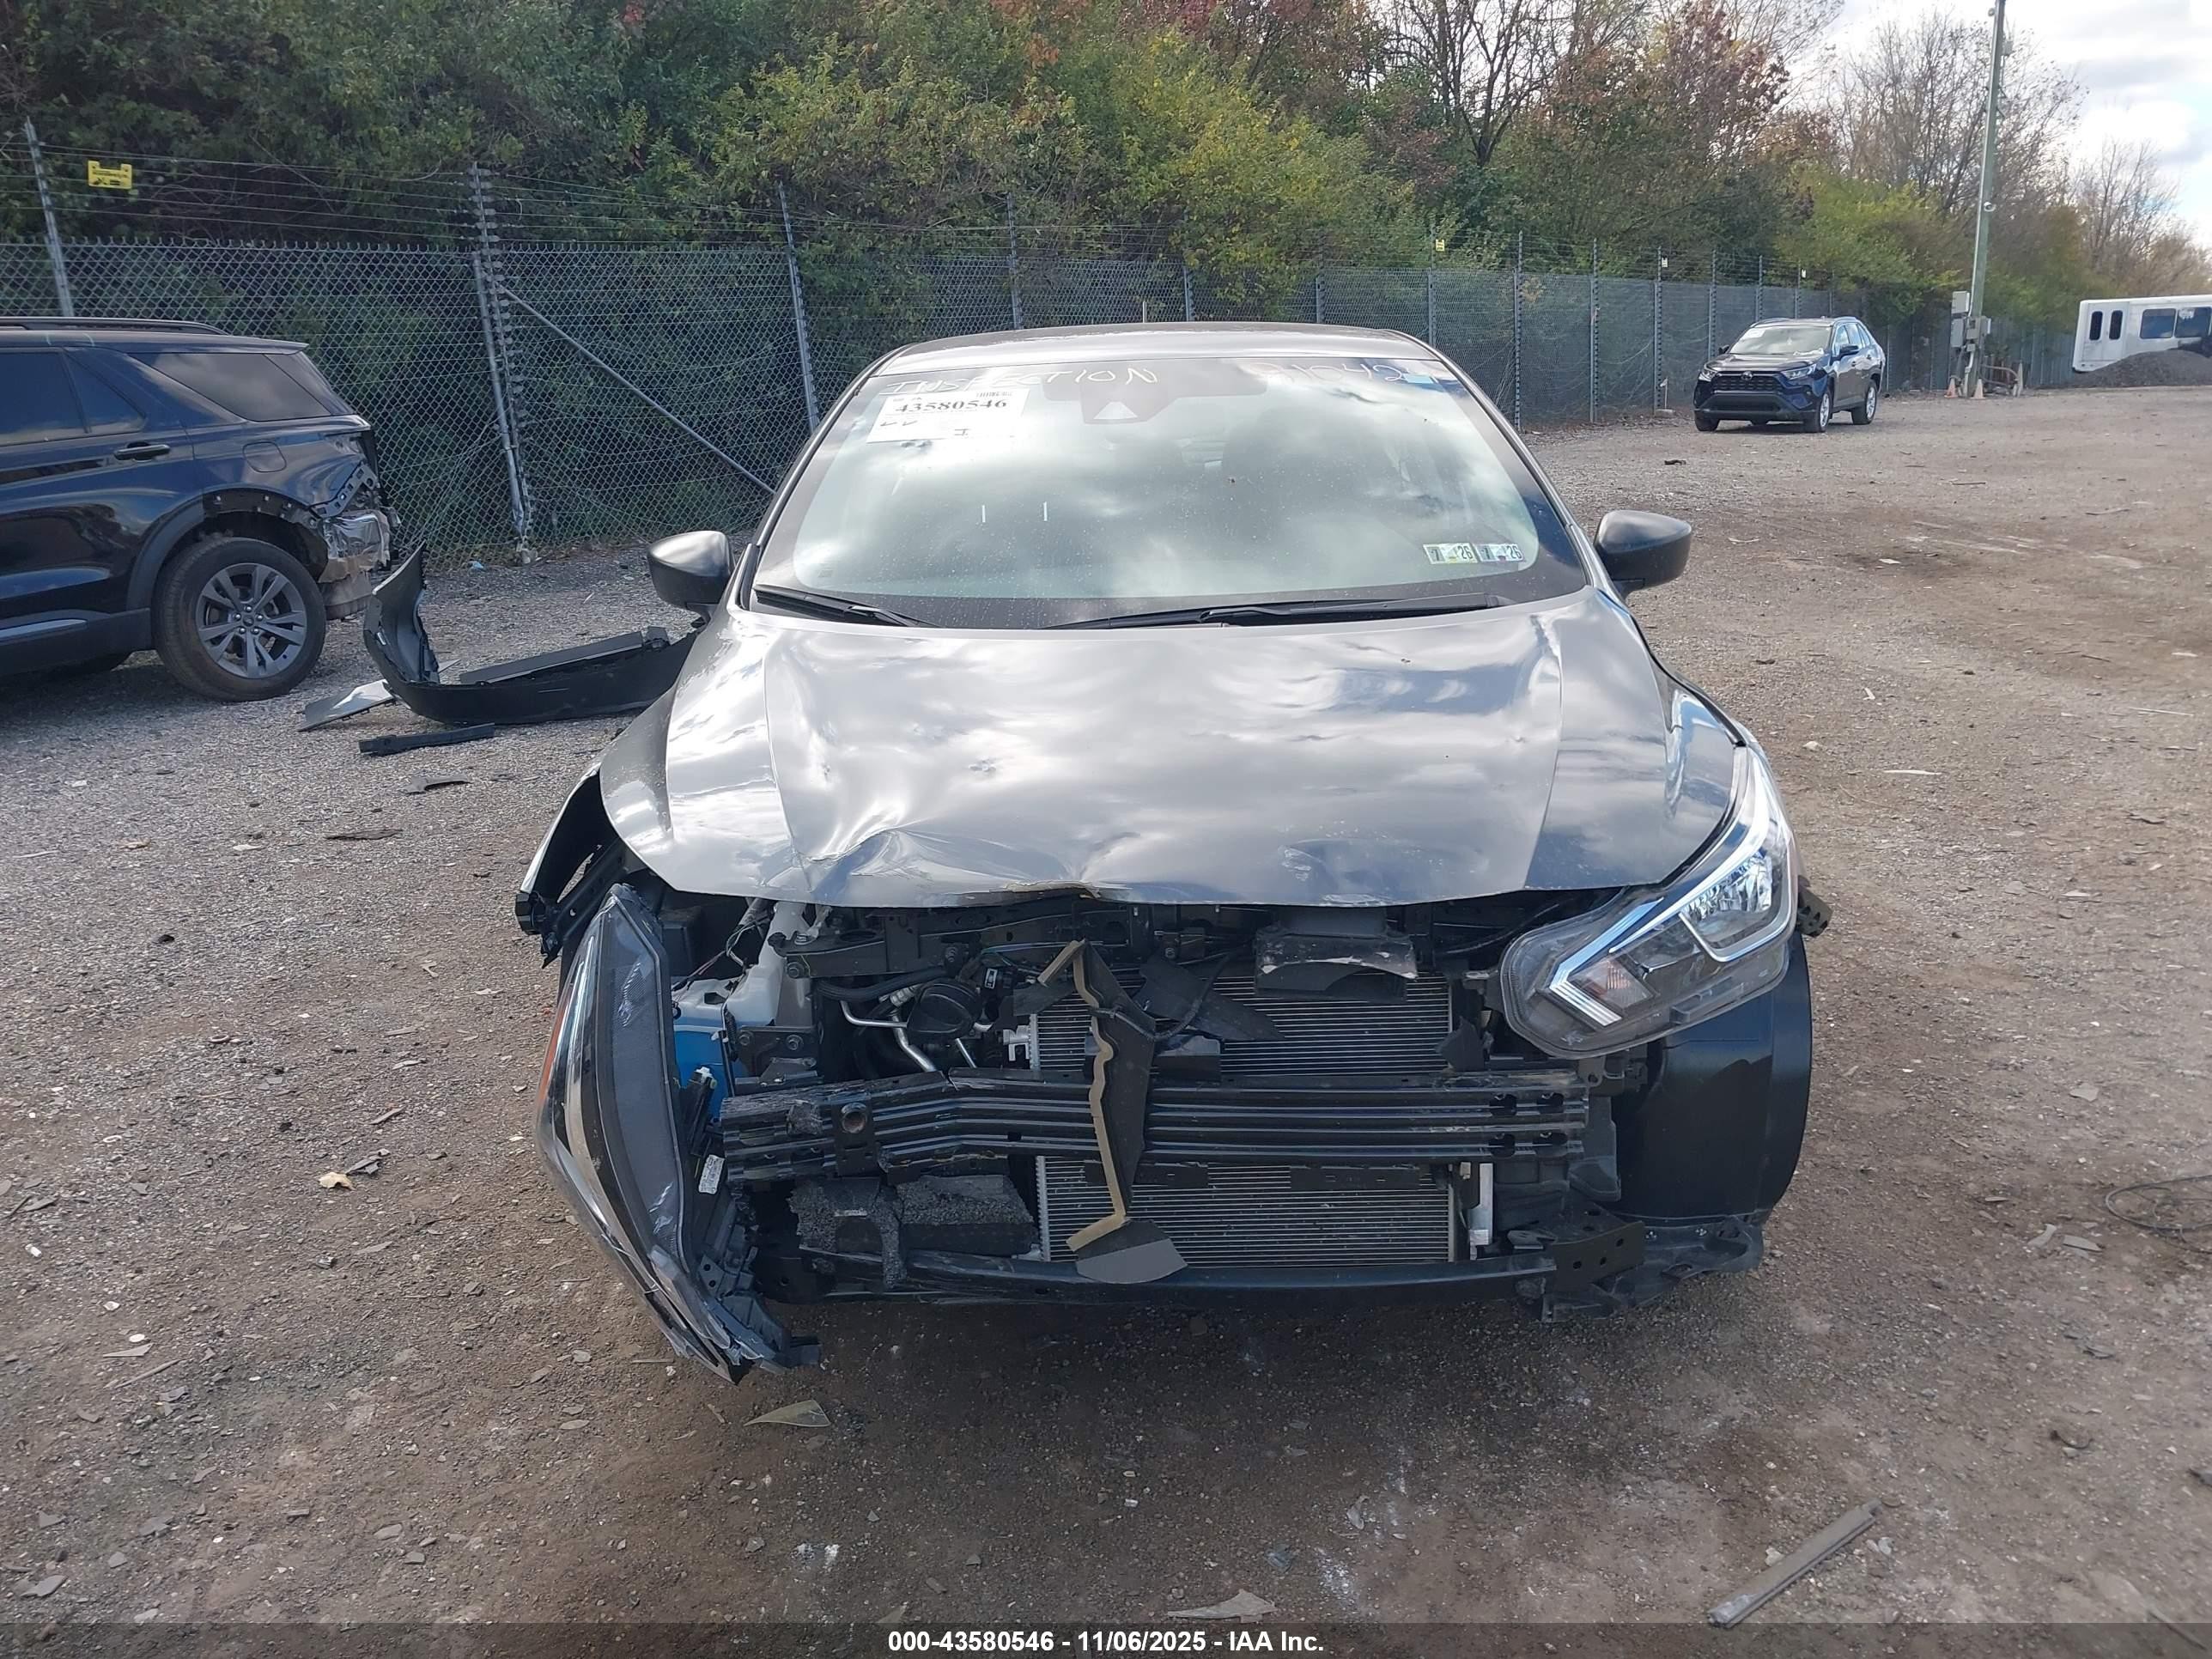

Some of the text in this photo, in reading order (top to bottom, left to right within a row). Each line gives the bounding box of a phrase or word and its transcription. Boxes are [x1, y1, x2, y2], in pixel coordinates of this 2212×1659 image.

[895, 399, 1007, 412] 43580546
[1456, 545, 1474, 560] 26
[1506, 545, 1522, 559] 26
